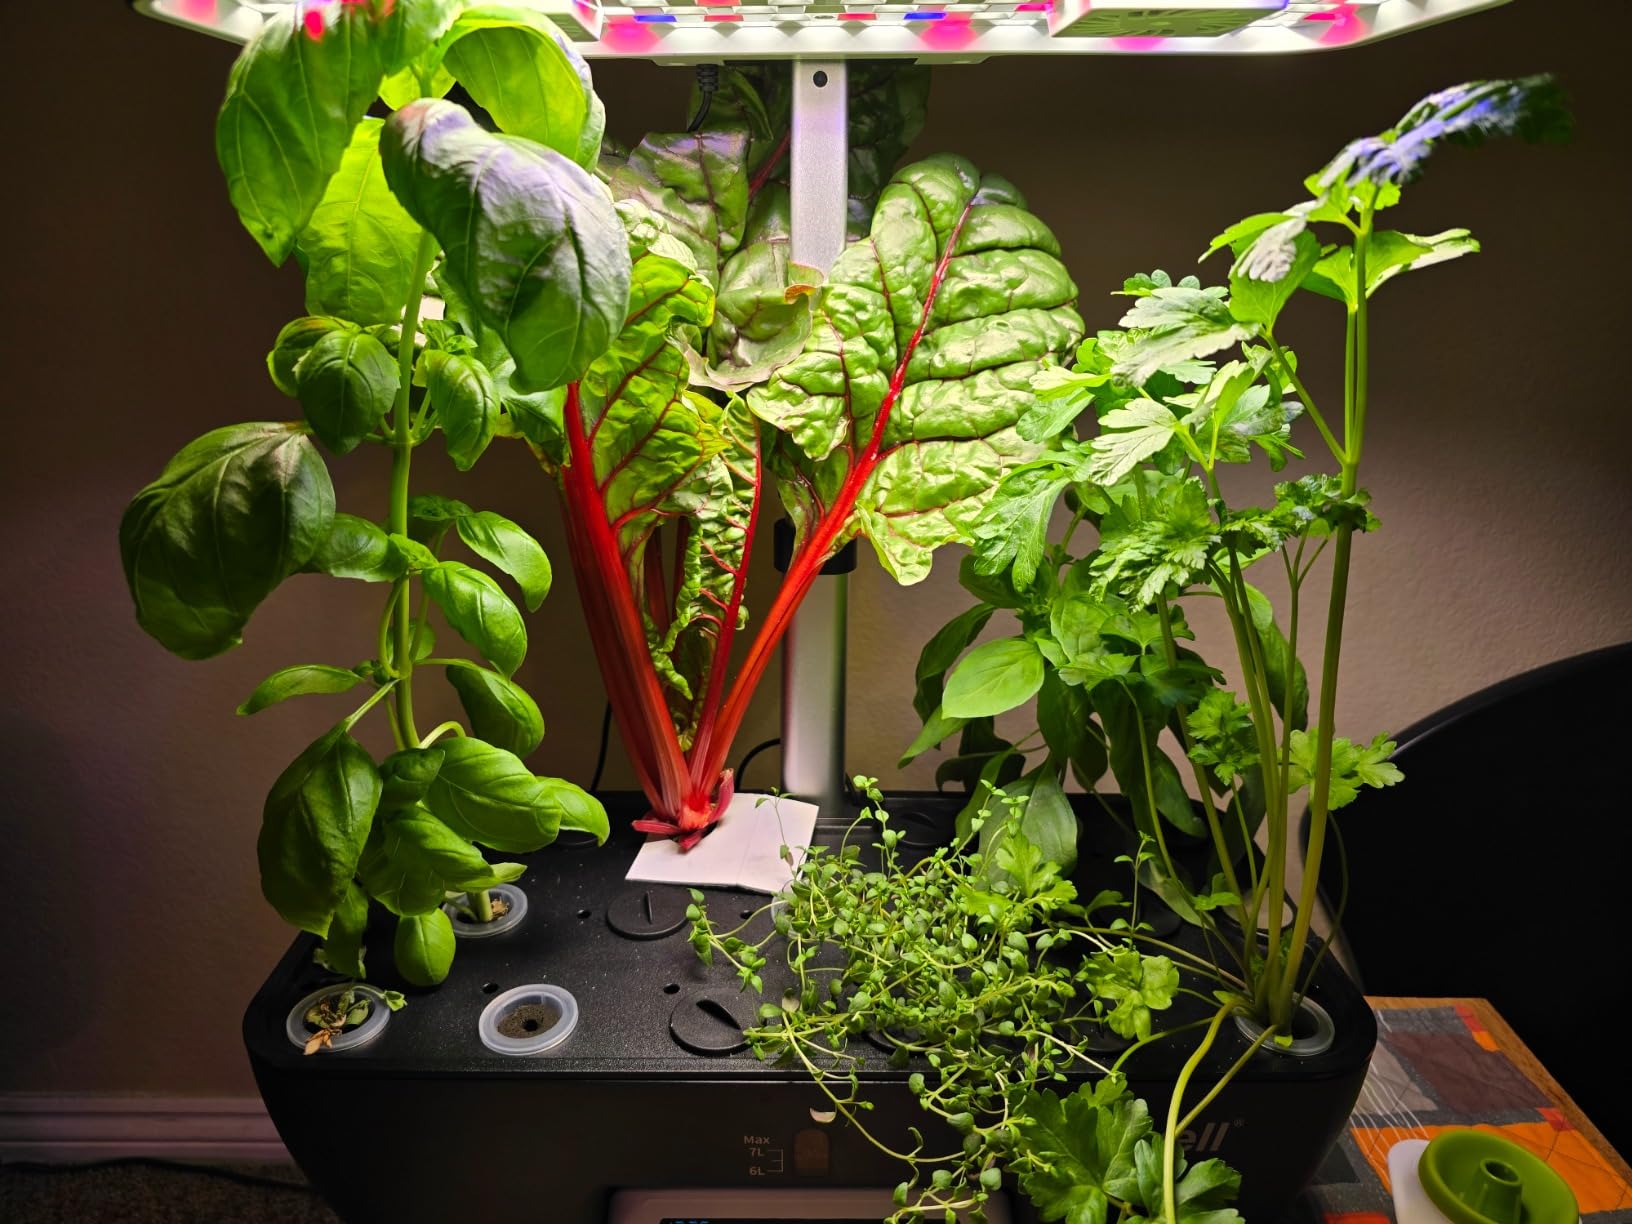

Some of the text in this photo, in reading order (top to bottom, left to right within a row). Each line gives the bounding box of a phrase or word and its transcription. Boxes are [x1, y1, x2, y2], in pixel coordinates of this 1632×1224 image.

[743, 1135, 770, 1145] Max
[748, 1147, 765, 1157] 7L
[749, 1166, 766, 1176] 6L
